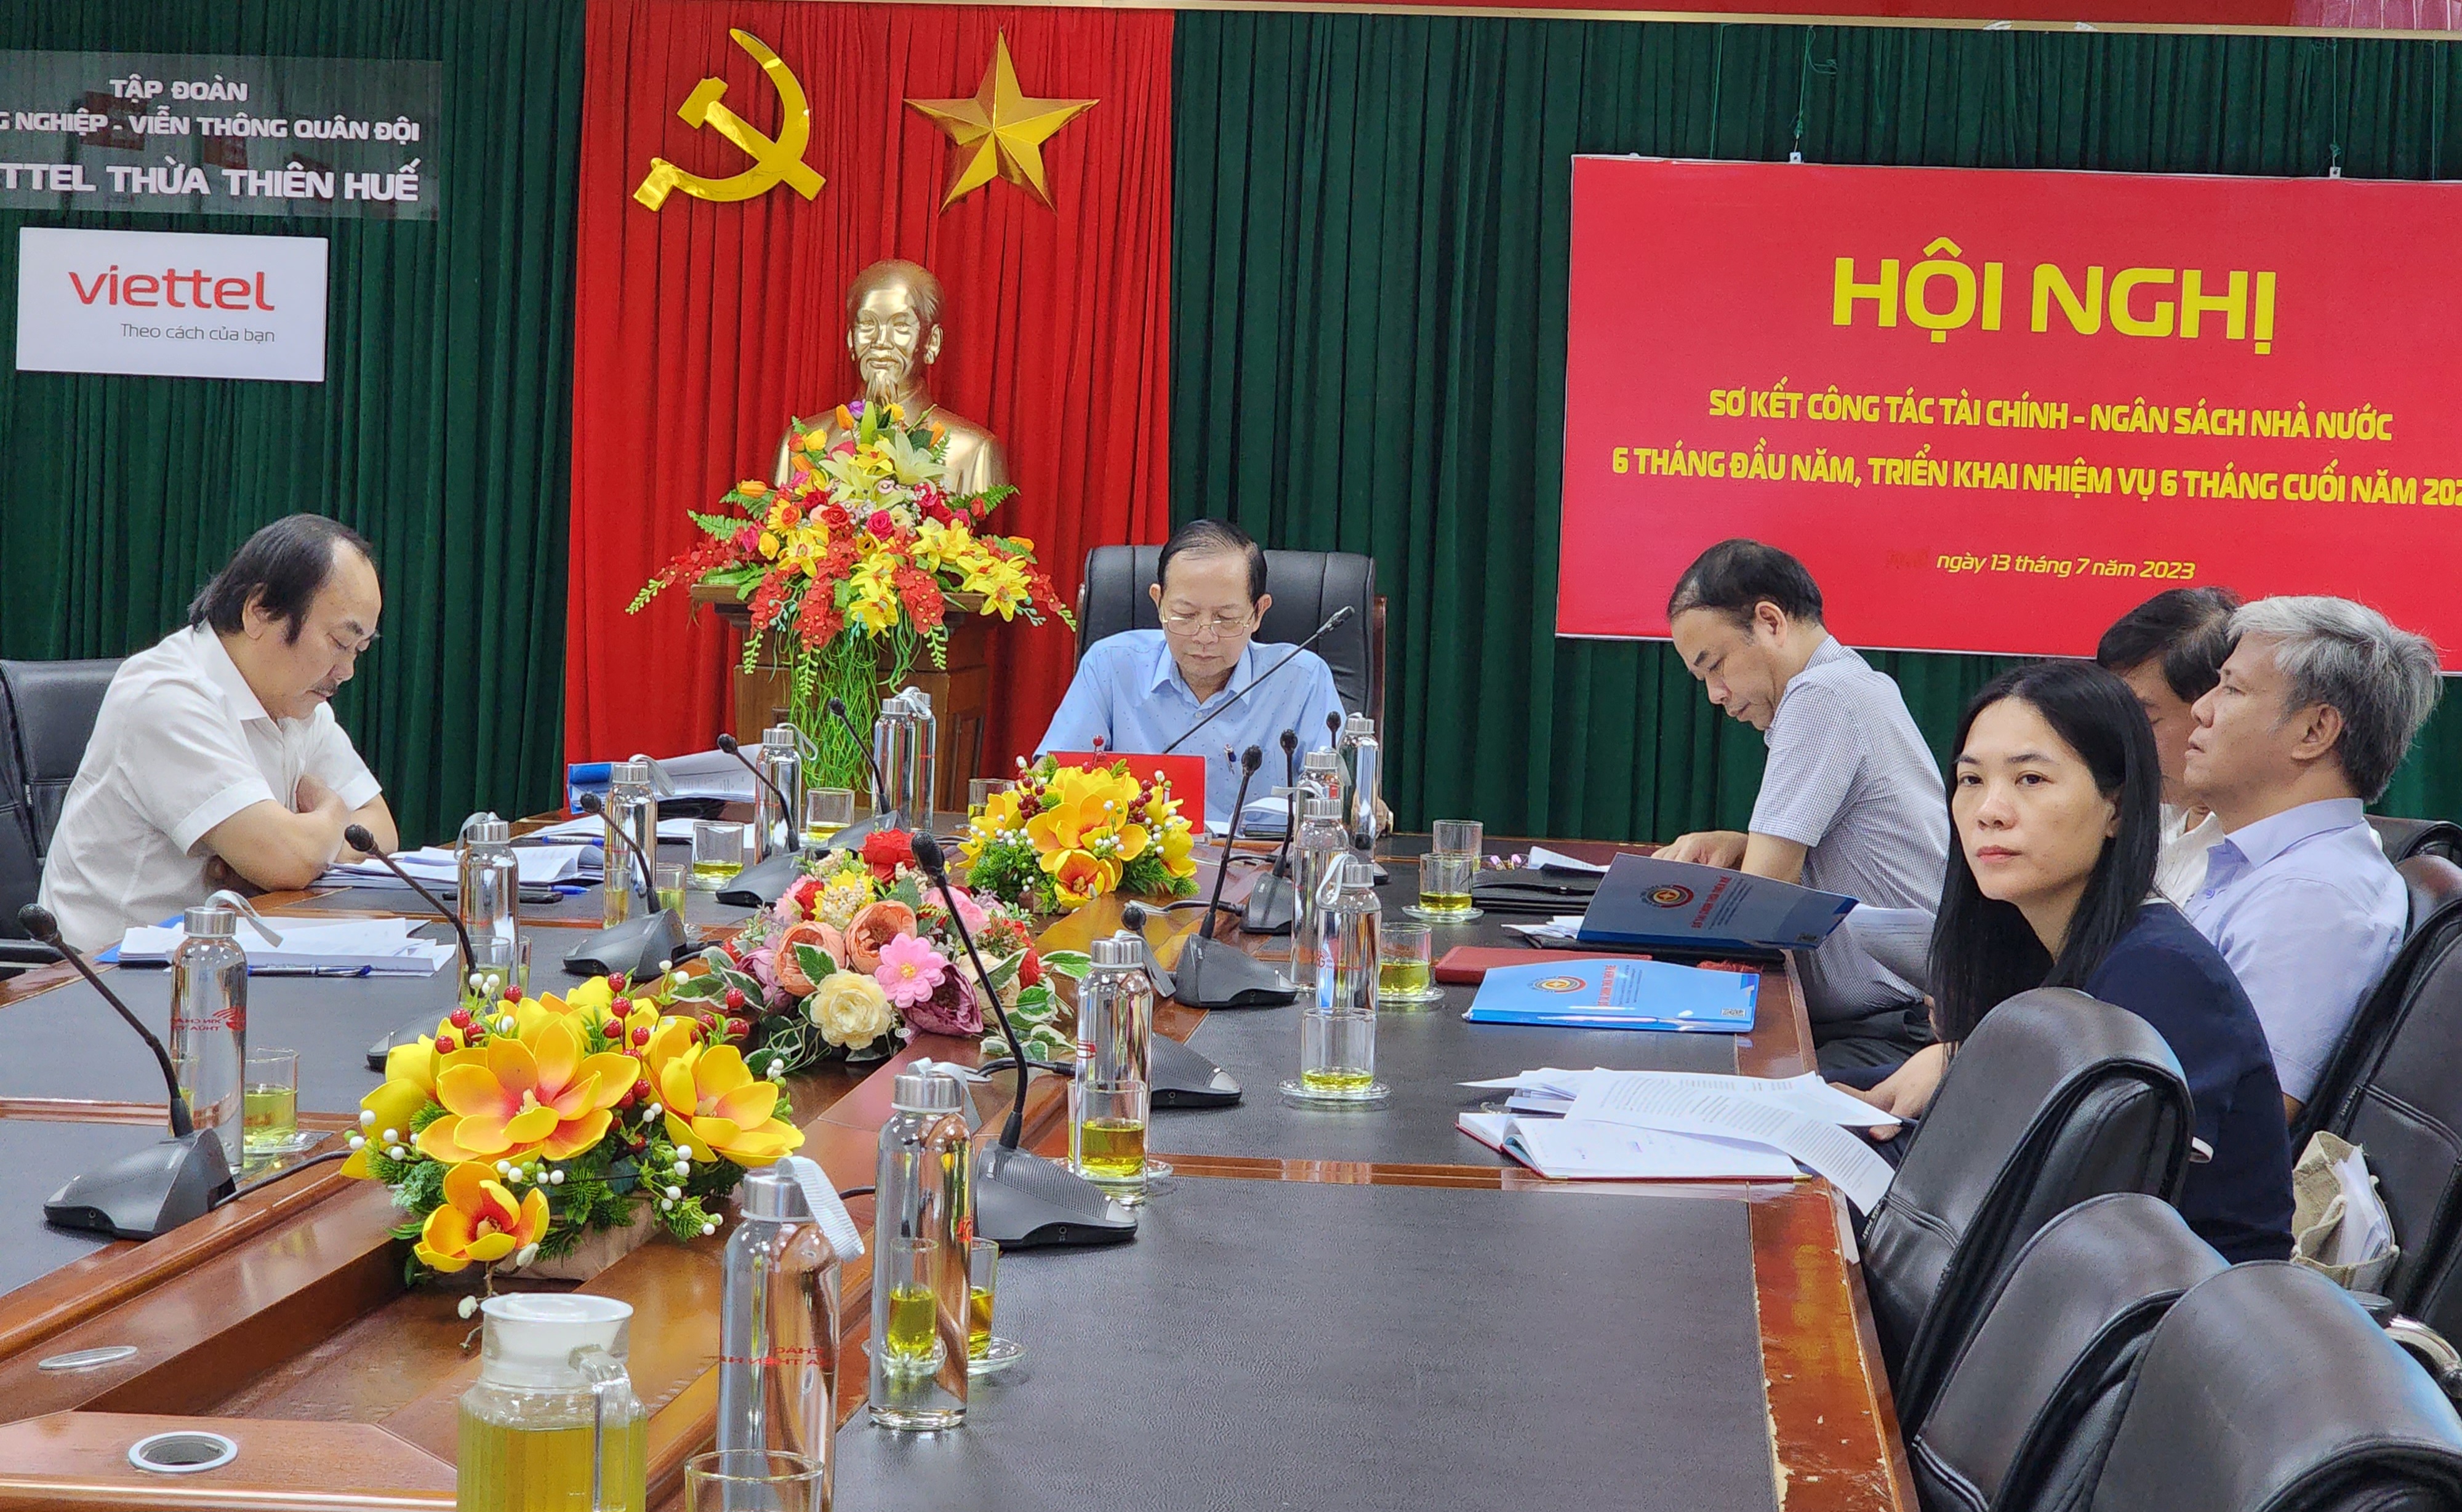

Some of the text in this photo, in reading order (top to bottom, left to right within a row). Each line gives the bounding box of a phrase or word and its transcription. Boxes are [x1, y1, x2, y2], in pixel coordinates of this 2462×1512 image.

[110, 73, 248, 103] TẬP ĐOÀN
[15, 107, 108, 136] NGHIỆP
[129, 105, 190, 135] VIỄN
[196, 112, 288, 137] THÔNG
[294, 115, 369, 140] QUÂN
[374, 116, 420, 145] ĐỘI
[106, 155, 211, 195] THỪA
[222, 161, 334, 199] THIÊN
[344, 158, 422, 201] HUẾ
[69, 265, 275, 311] viettel
[1833, 237, 2277, 355] HỘI NGHỊ
[121, 323, 275, 343] Theo cách của bạn
[1709, 386, 1746, 417] SƠ
[1750, 377, 1803, 418] KẾT
[1807, 385, 1880, 422] CÔNG
[1884, 388, 1934, 424] TÁC
[1939, 389, 1981, 426] TÀI
[1986, 391, 2068, 430] CHÍNH
[2090, 397, 2170, 433] NGÂN
[2174, 398, 2246, 436] SÁCH
[2251, 401, 2311, 438] NHÀ
[2316, 403, 2393, 441] NƯỚC
[1613, 447, 1629, 474] 6
[1634, 441, 1725, 478] THÁNG
[1730, 438, 1786, 480] ĐẦU
[1791, 448, 1862, 488] NĂM,
[1867, 443, 1948, 487] TRIỂN
[1952, 460, 2018, 489] KHAI
[2023, 457, 2112, 498] NHIỆM
[2117, 468, 2156, 501] VỤ
[2161, 470, 2178, 497] 6
[2183, 462, 2278, 500] THÁNG
[2282, 458, 2346, 502] CUỐI
[2351, 469, 2417, 504] NĂM
[1936, 553, 1988, 574] ngày
[1991, 554, 2011, 571] 13
[2015, 555, 2072, 577] tháng
[2075, 558, 2090, 574] 7
[2091, 559, 2136, 577] năm
[2139, 561, 2196, 579] 2023
